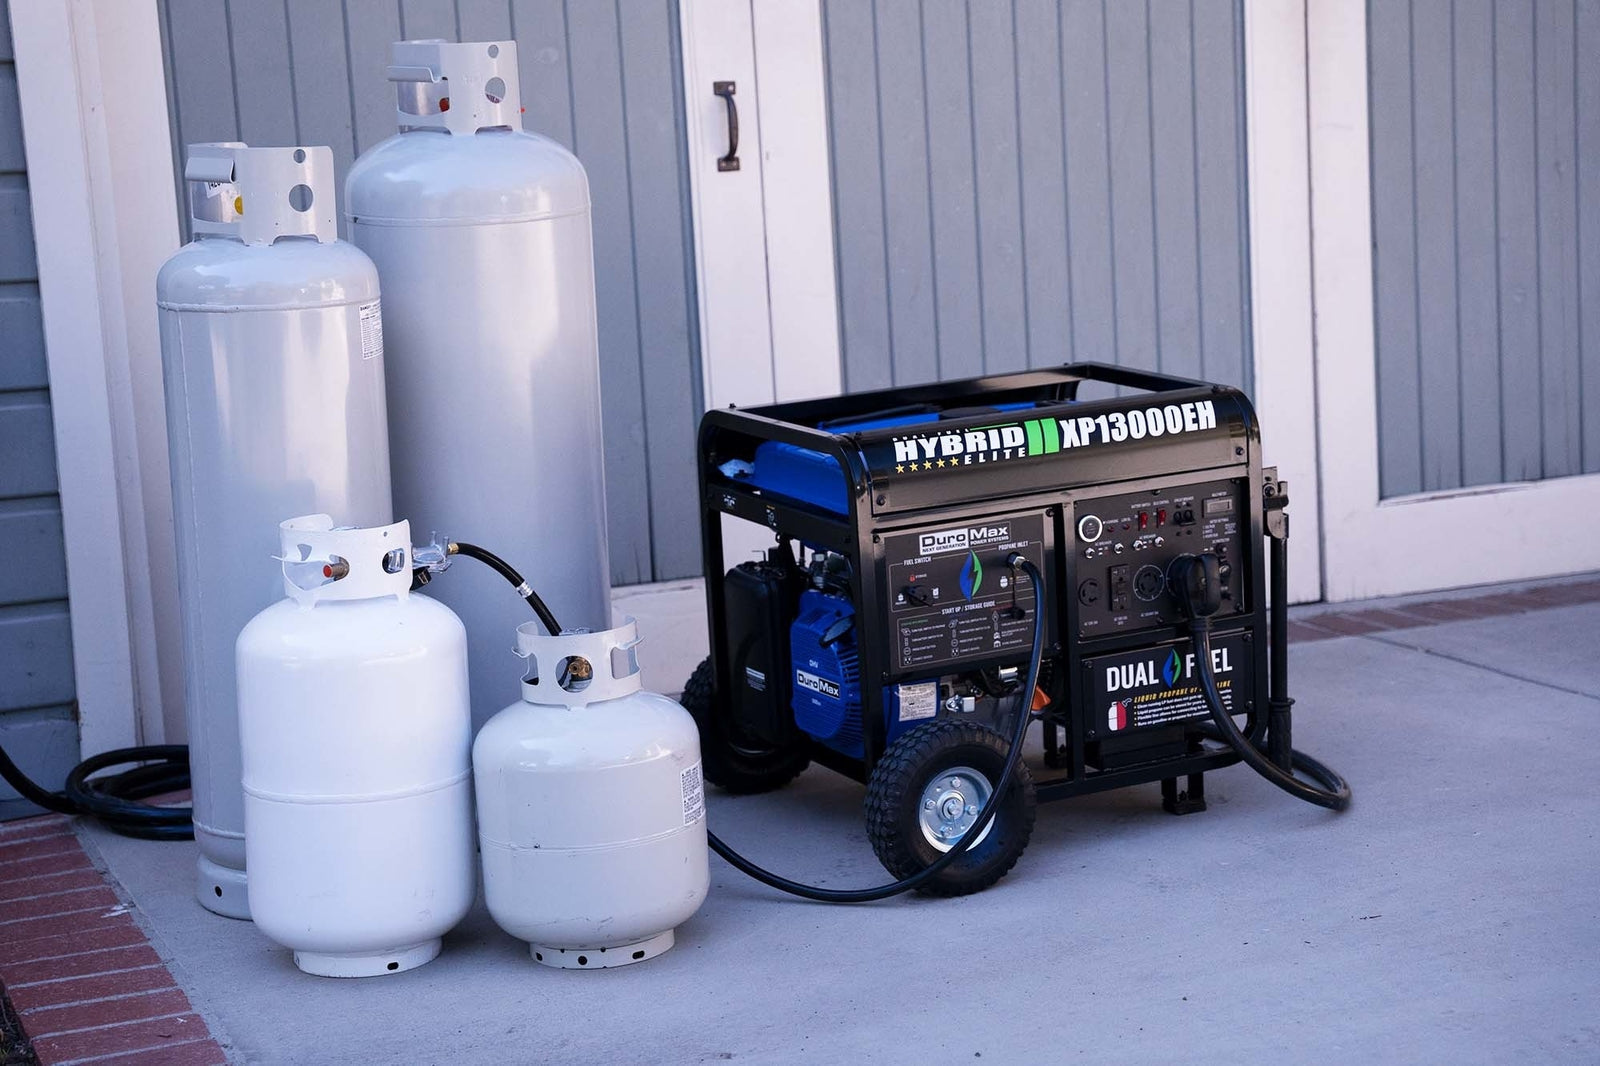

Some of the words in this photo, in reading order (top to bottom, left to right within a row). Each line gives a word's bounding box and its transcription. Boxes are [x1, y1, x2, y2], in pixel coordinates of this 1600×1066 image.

[894, 426, 1025, 463] HYBRID
[1058, 400, 1217, 449] XP13000EH
[964, 447, 1026, 465] ELITE
[936, 542, 966, 551] GENERATION
[988, 535, 1009, 543] SYSTEMS
[1106, 660, 1159, 692] DUAL
[1185, 647, 1233, 678] FEL
[1134, 693, 1157, 703] LIQUID
[1158, 687, 1188, 698] PROPANE
